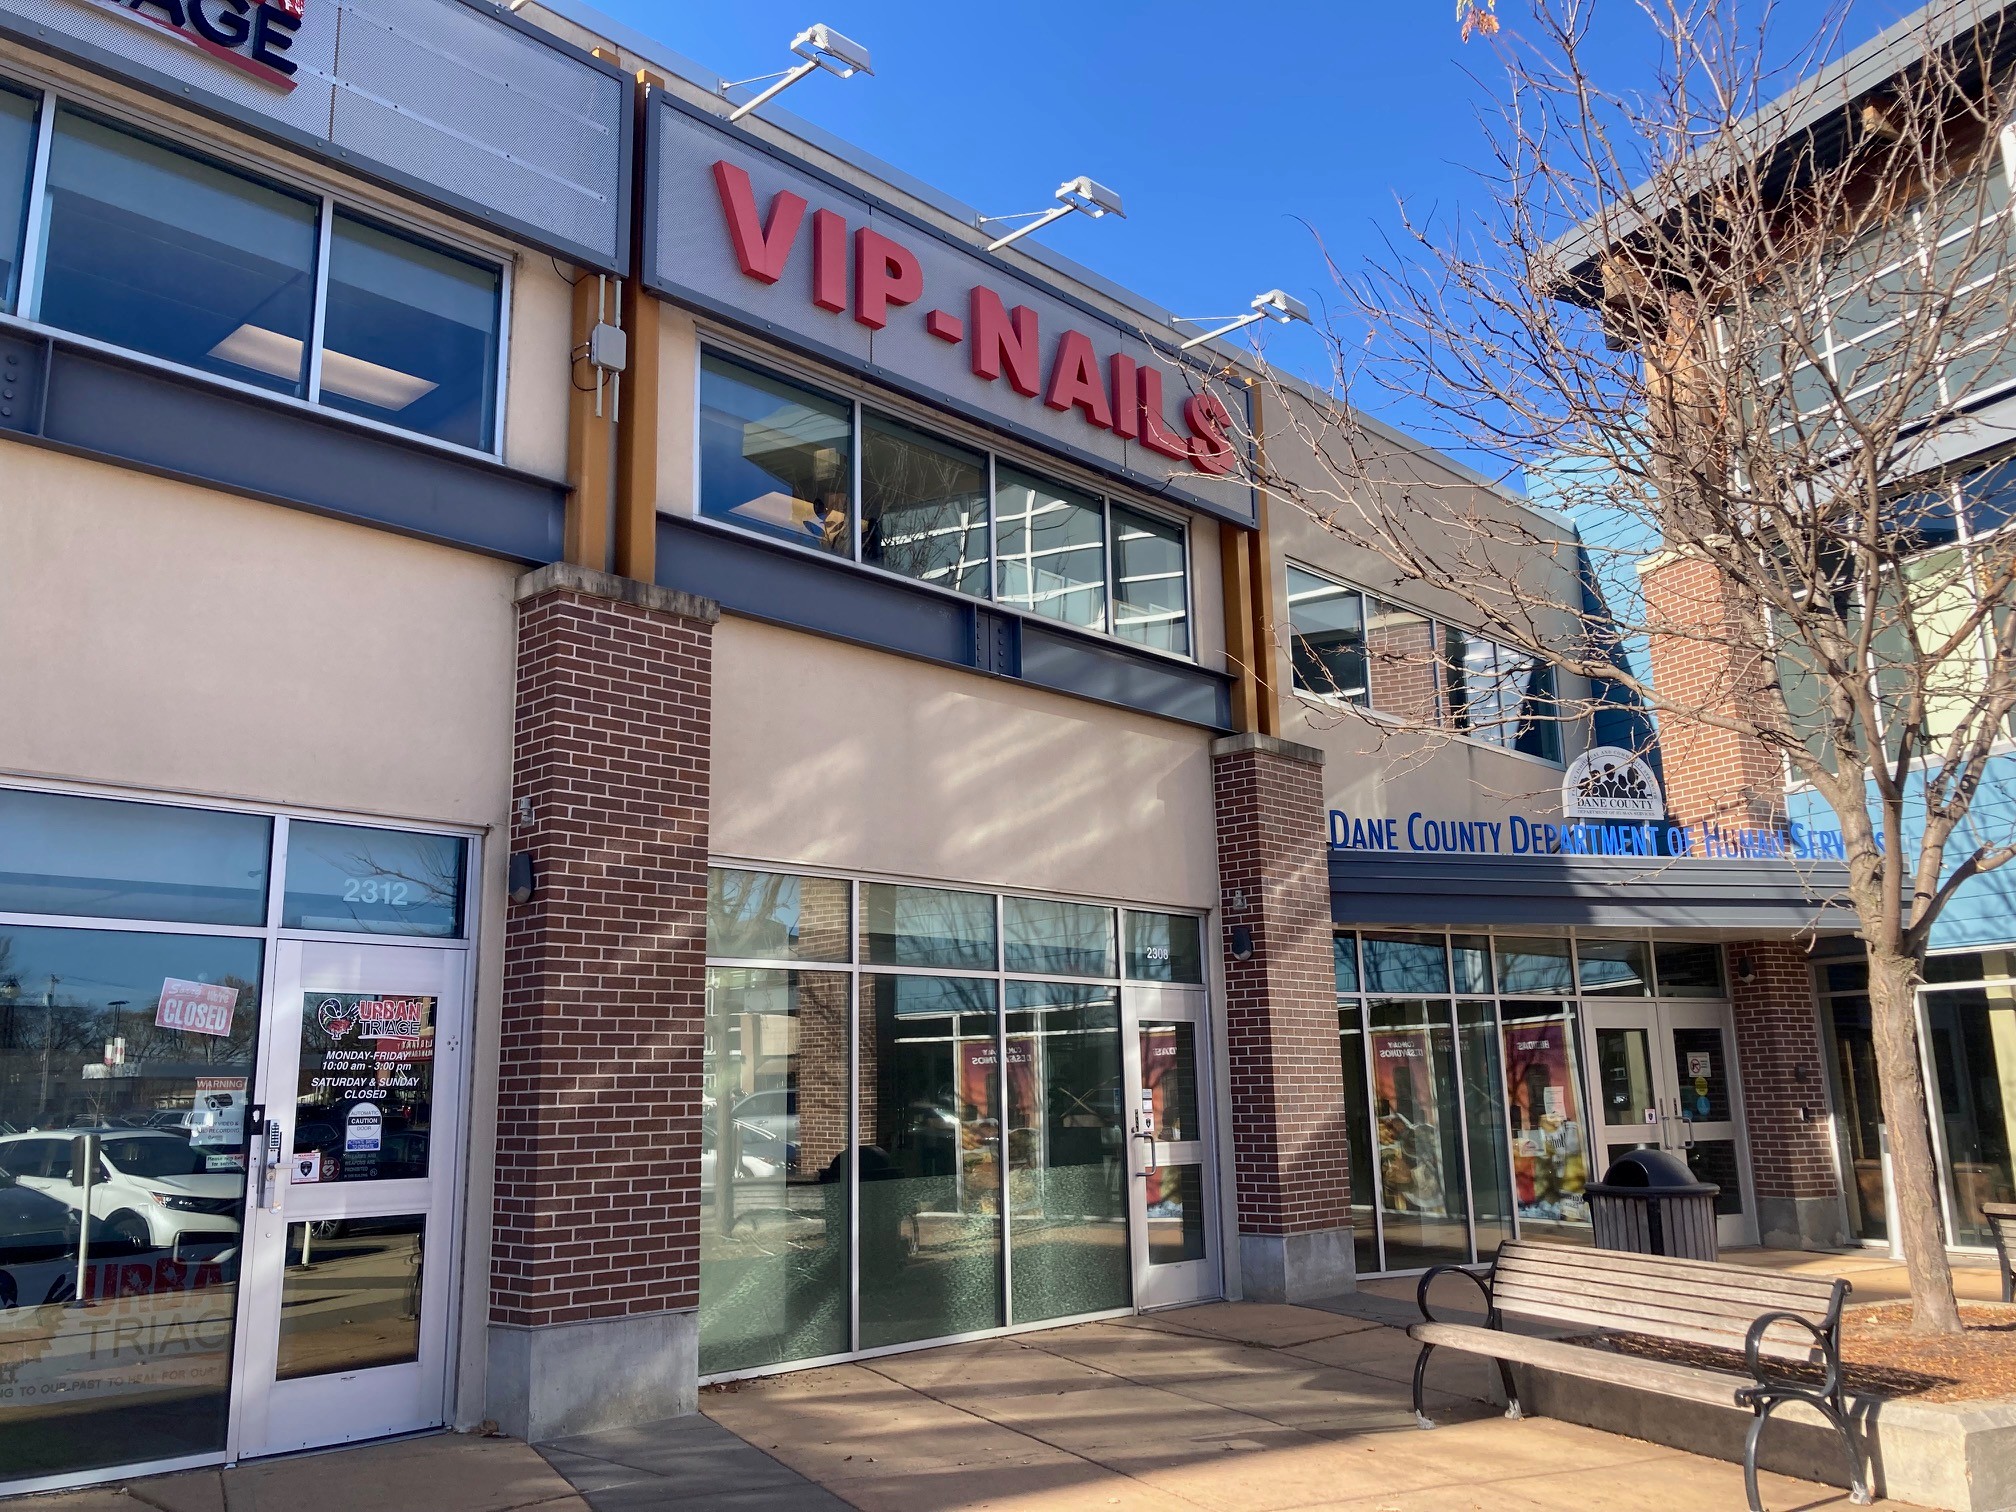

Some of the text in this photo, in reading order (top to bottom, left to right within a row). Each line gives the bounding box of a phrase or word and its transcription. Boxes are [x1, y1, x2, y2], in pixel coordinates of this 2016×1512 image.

[713, 160, 1234, 475] VIP-NAILS
[1577, 798, 1653, 809] DANE COUNTY
[343, 878, 408, 905] 2312
[1146, 946, 1169, 960] 2308
[164, 998, 227, 1031] CLOSED
[360, 1000, 421, 1021] URBAN
[359, 1020, 421, 1036] TRIAGE
[326, 1050, 410, 1061] MONDAY-FRIDAY
[322, 1061, 348, 1071] 10:00
[351, 1062, 366, 1071] am
[374, 1061, 395, 1071] 3:00
[396, 1062, 412, 1072] pm
[197, 1080, 243, 1088] WARNING
[311, 1077, 420, 1087] SATURDAY & SUNDAY
[344, 1089, 387, 1099] CLOSED
[20, 1386, 37, 1397] TO
[71, 1379, 102, 1391] PAST
[108, 1376, 124, 1387] TO
[162, 1370, 186, 1381] FOR
